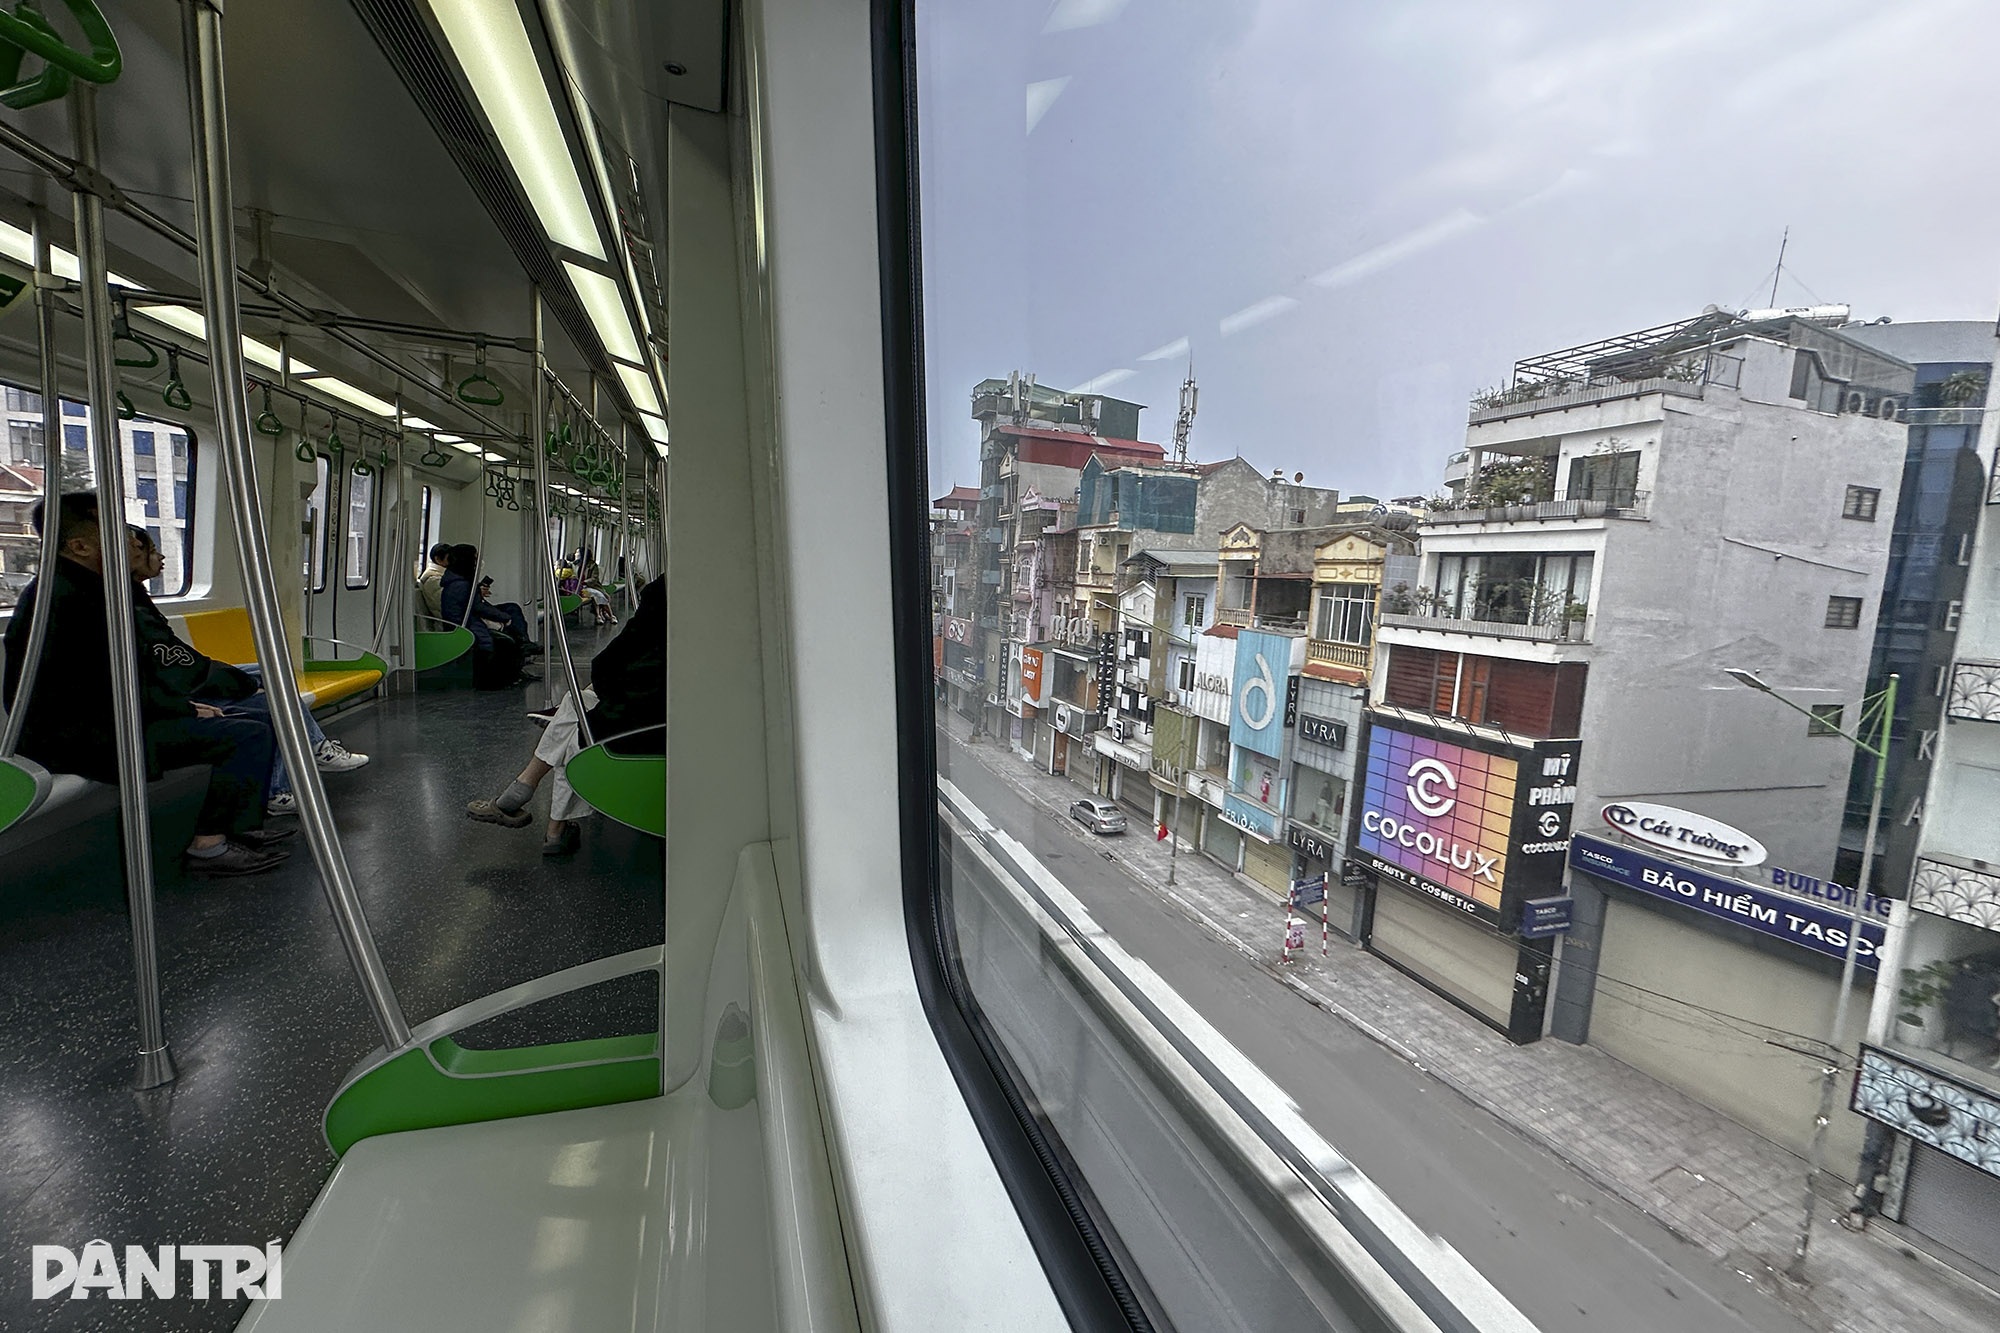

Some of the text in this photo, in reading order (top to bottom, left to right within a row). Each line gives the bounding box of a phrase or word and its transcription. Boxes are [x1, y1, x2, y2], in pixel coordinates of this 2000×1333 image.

[1198, 672, 1229, 696] ALORA
[1287, 679, 1297, 725] LYRA
[1304, 720, 1337, 742] LYRA
[1292, 831, 1324, 859] LYRA
[1363, 811, 1499, 883] COCOLUX
[1581, 849, 1613, 864] TASCO
[1640, 818, 1742, 859] Cát Tường
[1372, 859, 1476, 912] BEAUTY & COSMETIC
[1642, 868, 1697, 897] BẢO
[1702, 894, 1778, 925] HIỂM
